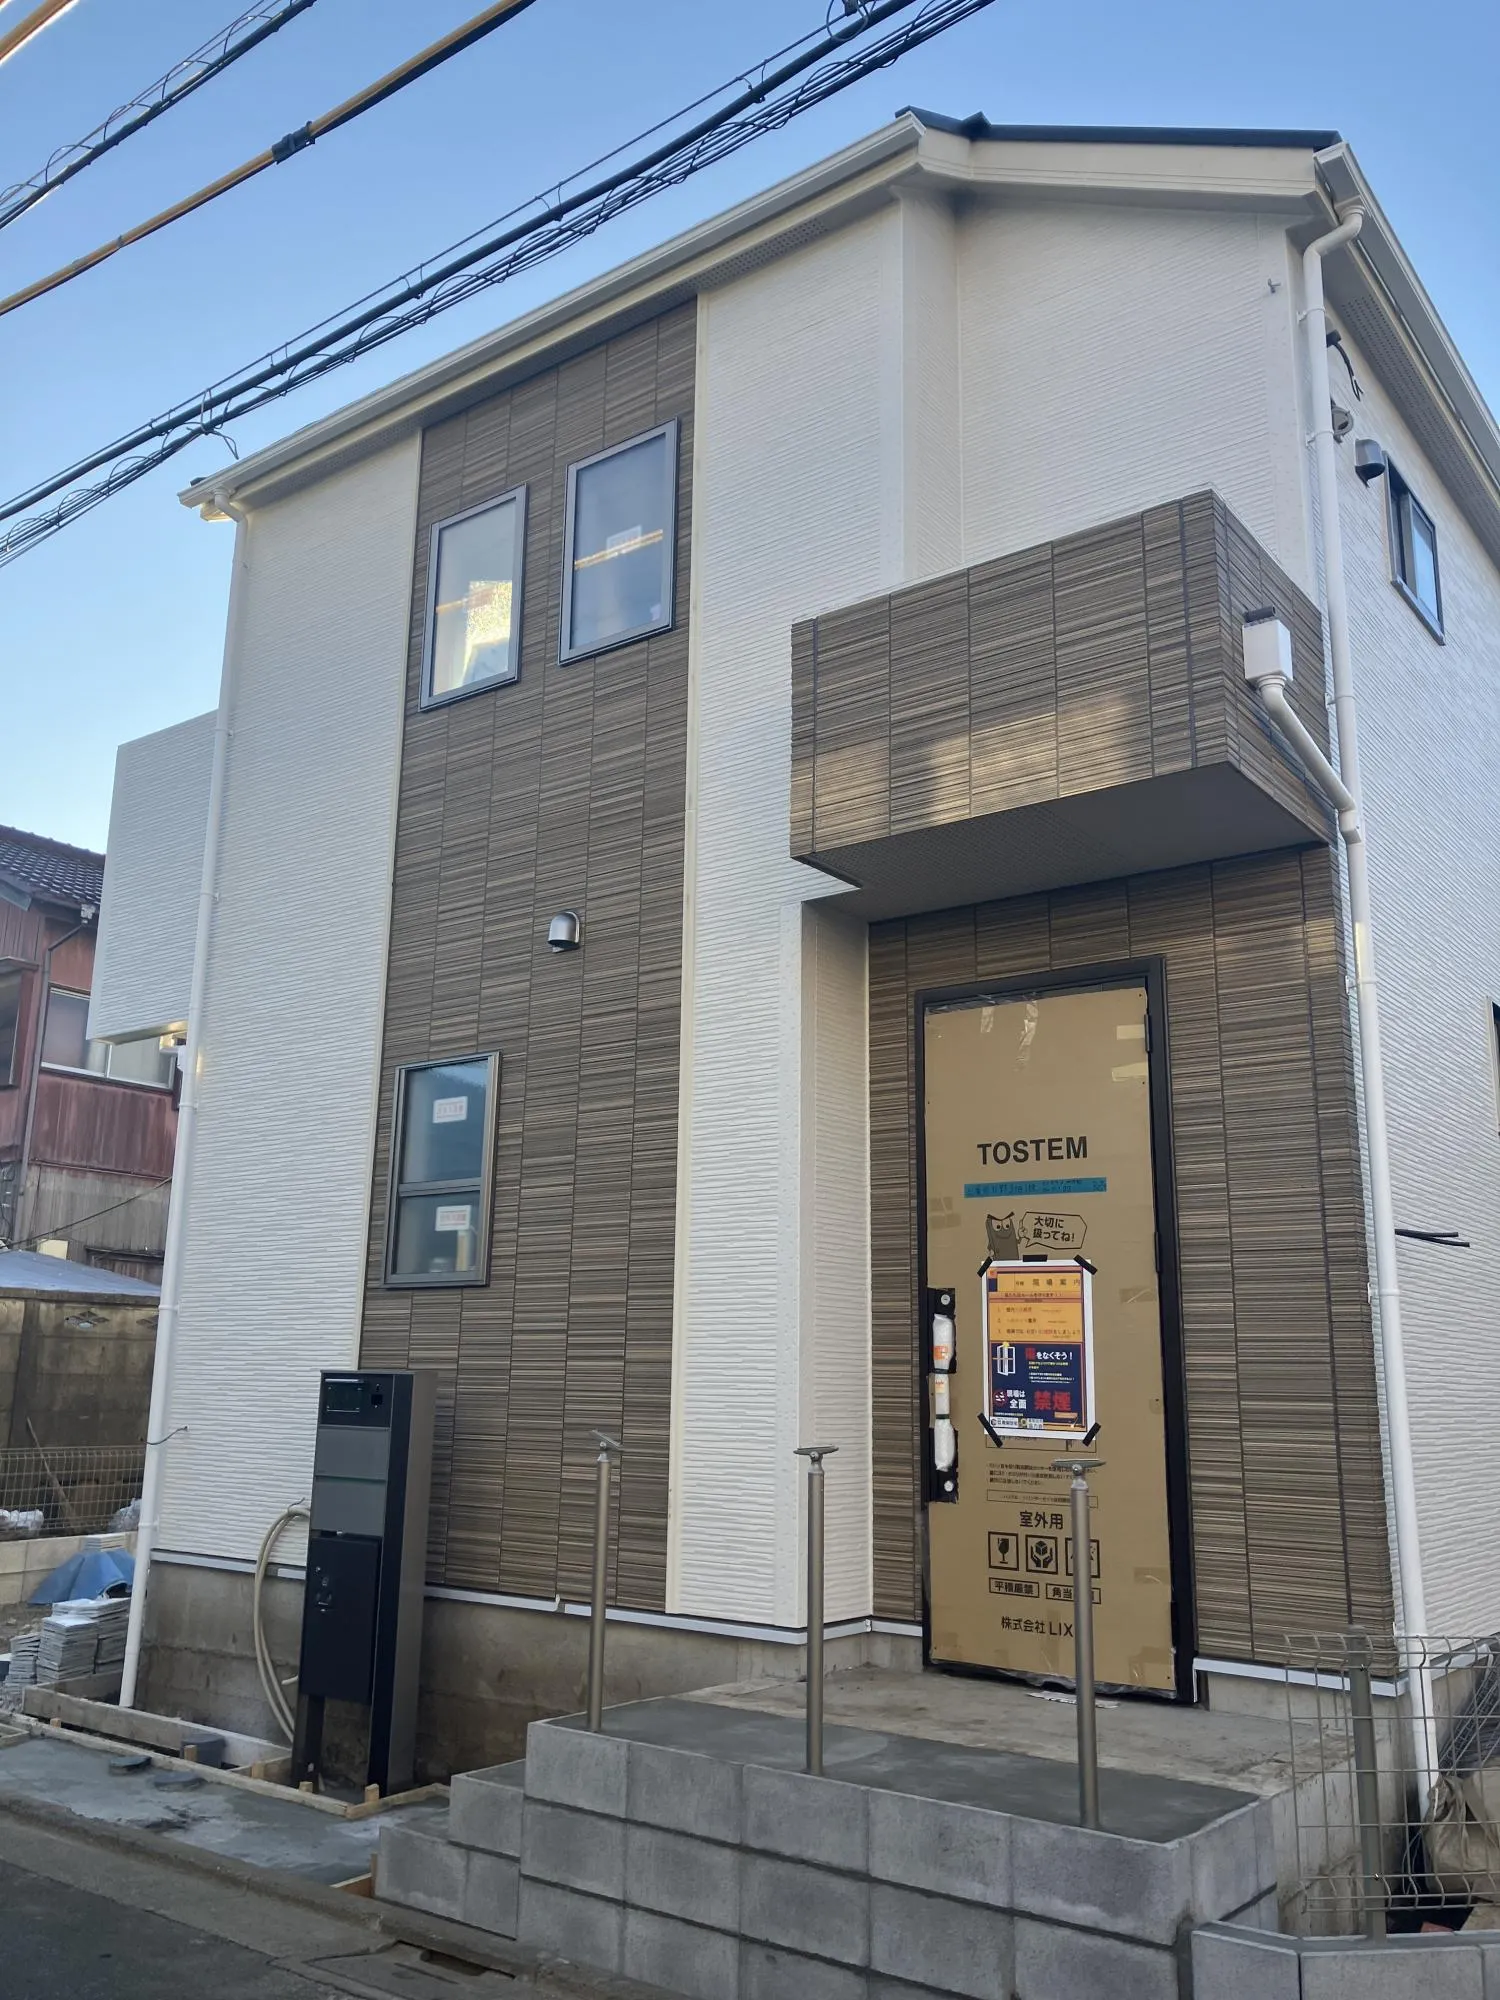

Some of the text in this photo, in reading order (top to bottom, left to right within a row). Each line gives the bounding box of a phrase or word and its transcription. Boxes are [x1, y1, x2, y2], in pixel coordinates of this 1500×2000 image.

[977, 1136, 1088, 1165] TOSTEM
[1034, 1216, 1065, 1229] 大切に
[1009, 1399, 1027, 1409] 全面
[1034, 1390, 1072, 1411] 禁煙
[1019, 1510, 1064, 1530] 室外用
[1001, 1616, 1074, 1638] 株式会社 LIX
